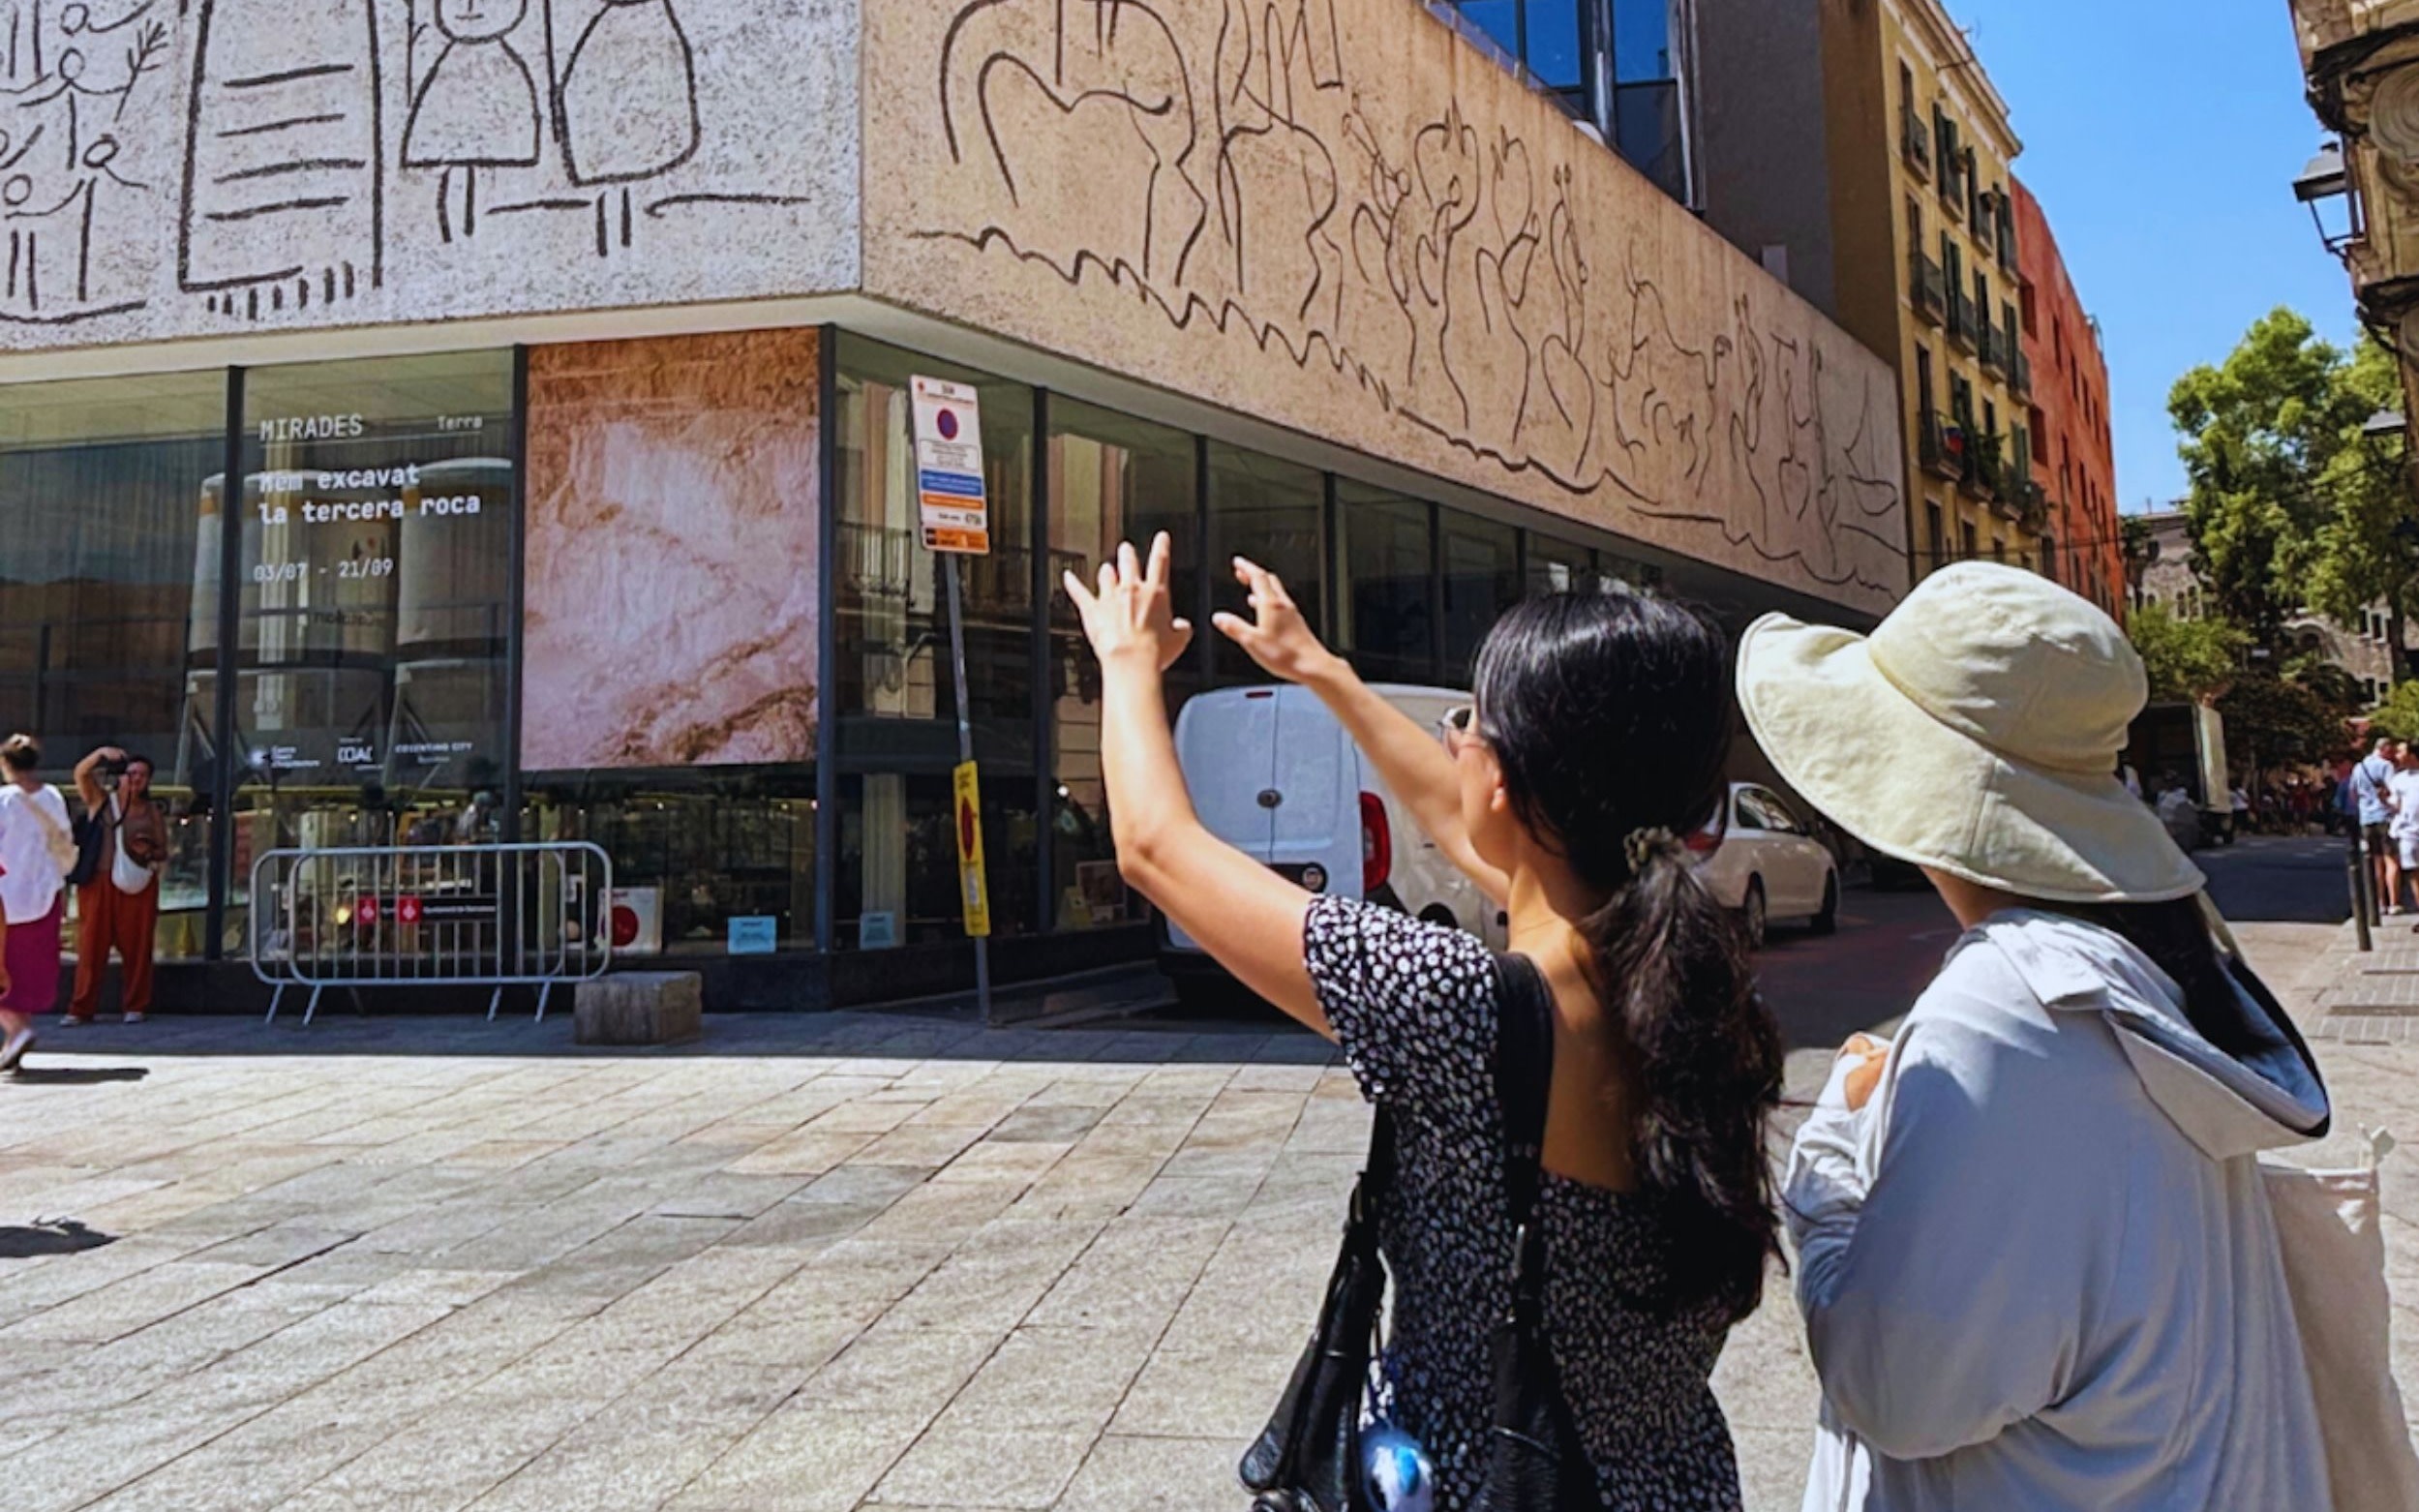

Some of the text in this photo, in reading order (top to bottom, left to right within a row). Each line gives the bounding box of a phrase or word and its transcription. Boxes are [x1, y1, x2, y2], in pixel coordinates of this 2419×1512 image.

[259, 413, 364, 440] MIRADES
[437, 416, 483, 431] Terra
[317, 463, 420, 490] excavat
[257, 494, 481, 525] la tercera roca
[254, 560, 309, 582] 03/07
[339, 557, 394, 580] 21/09
